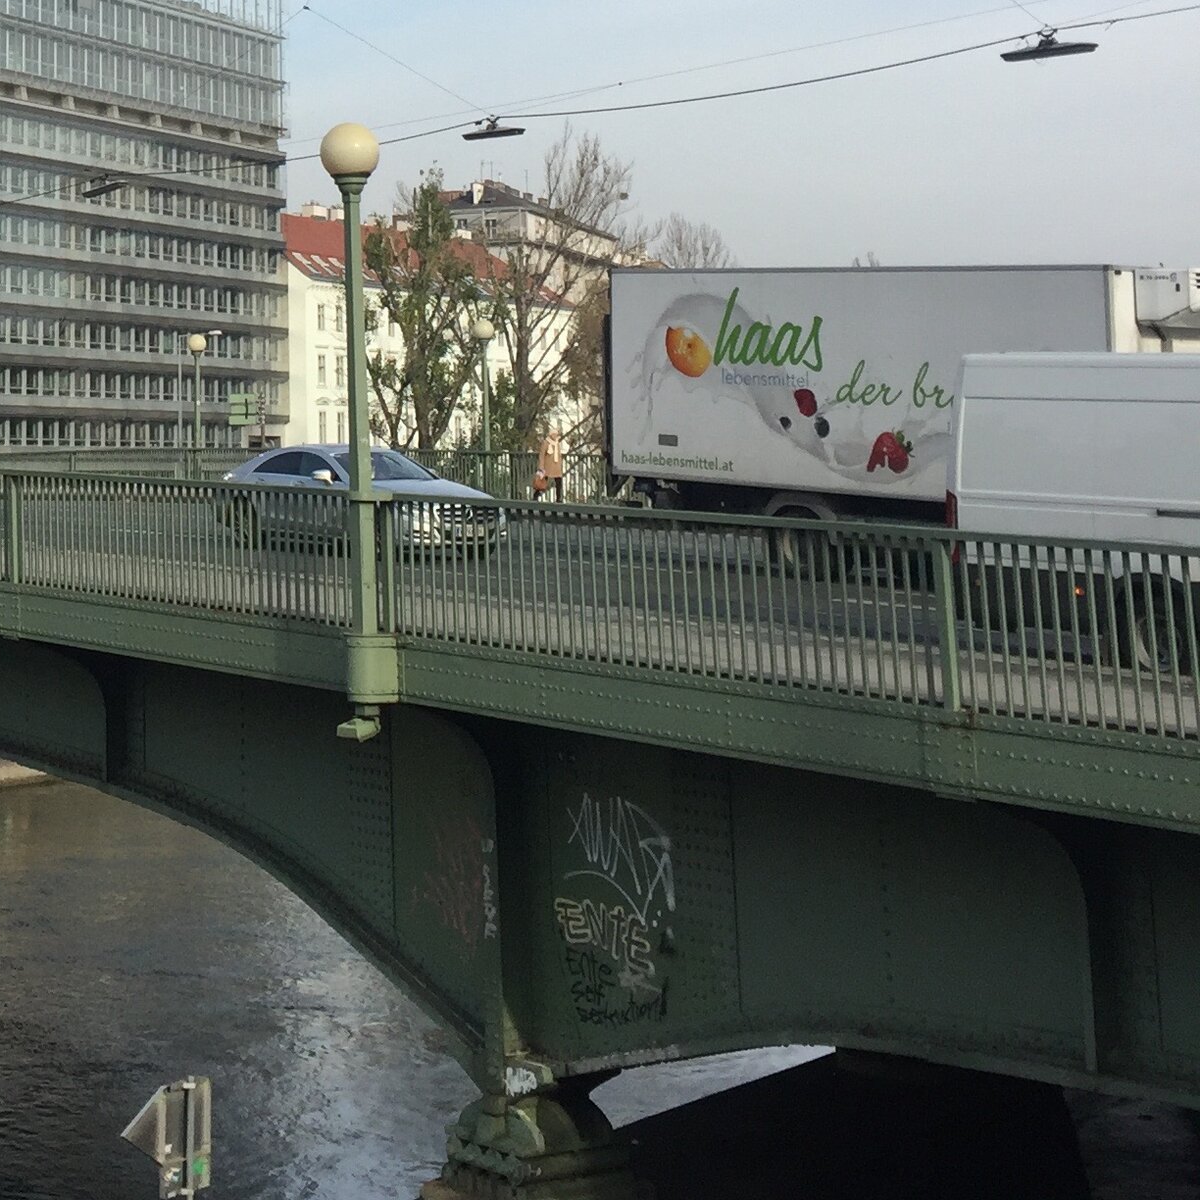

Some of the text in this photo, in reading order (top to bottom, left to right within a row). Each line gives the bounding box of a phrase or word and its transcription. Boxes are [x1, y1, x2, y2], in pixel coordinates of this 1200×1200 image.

[713, 287, 823, 372] haas
[721, 367, 809, 388] lebensmittel
[836, 359, 954, 408] der br
[621, 449, 734, 473] haas-lebensmittel.at
